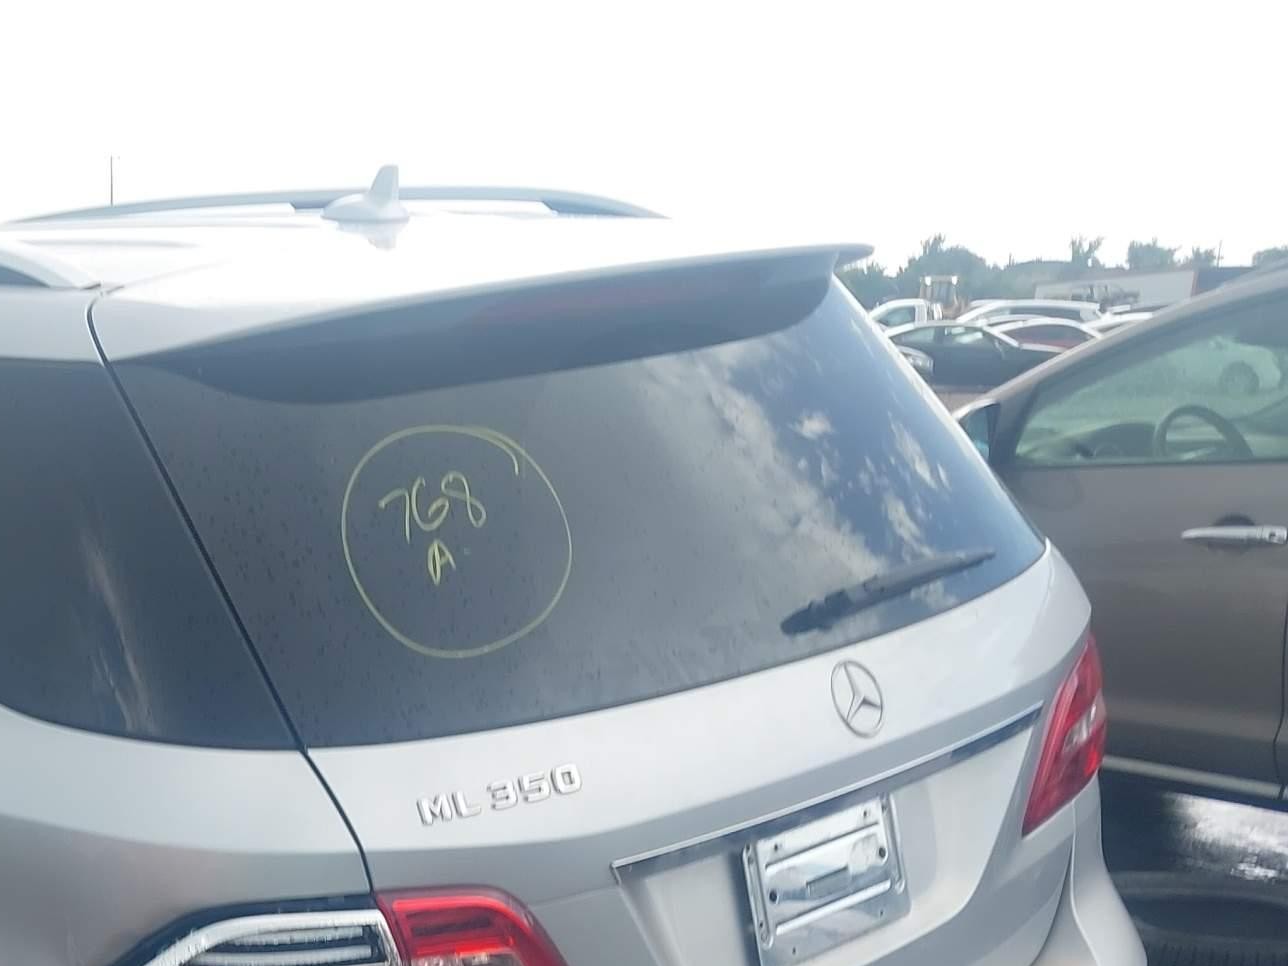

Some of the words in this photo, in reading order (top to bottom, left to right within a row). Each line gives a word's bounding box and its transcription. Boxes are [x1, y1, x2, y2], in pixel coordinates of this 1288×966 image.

[378, 470, 487, 544] 768
[416, 790, 482, 825] ML
[486, 762, 583, 811] 350
